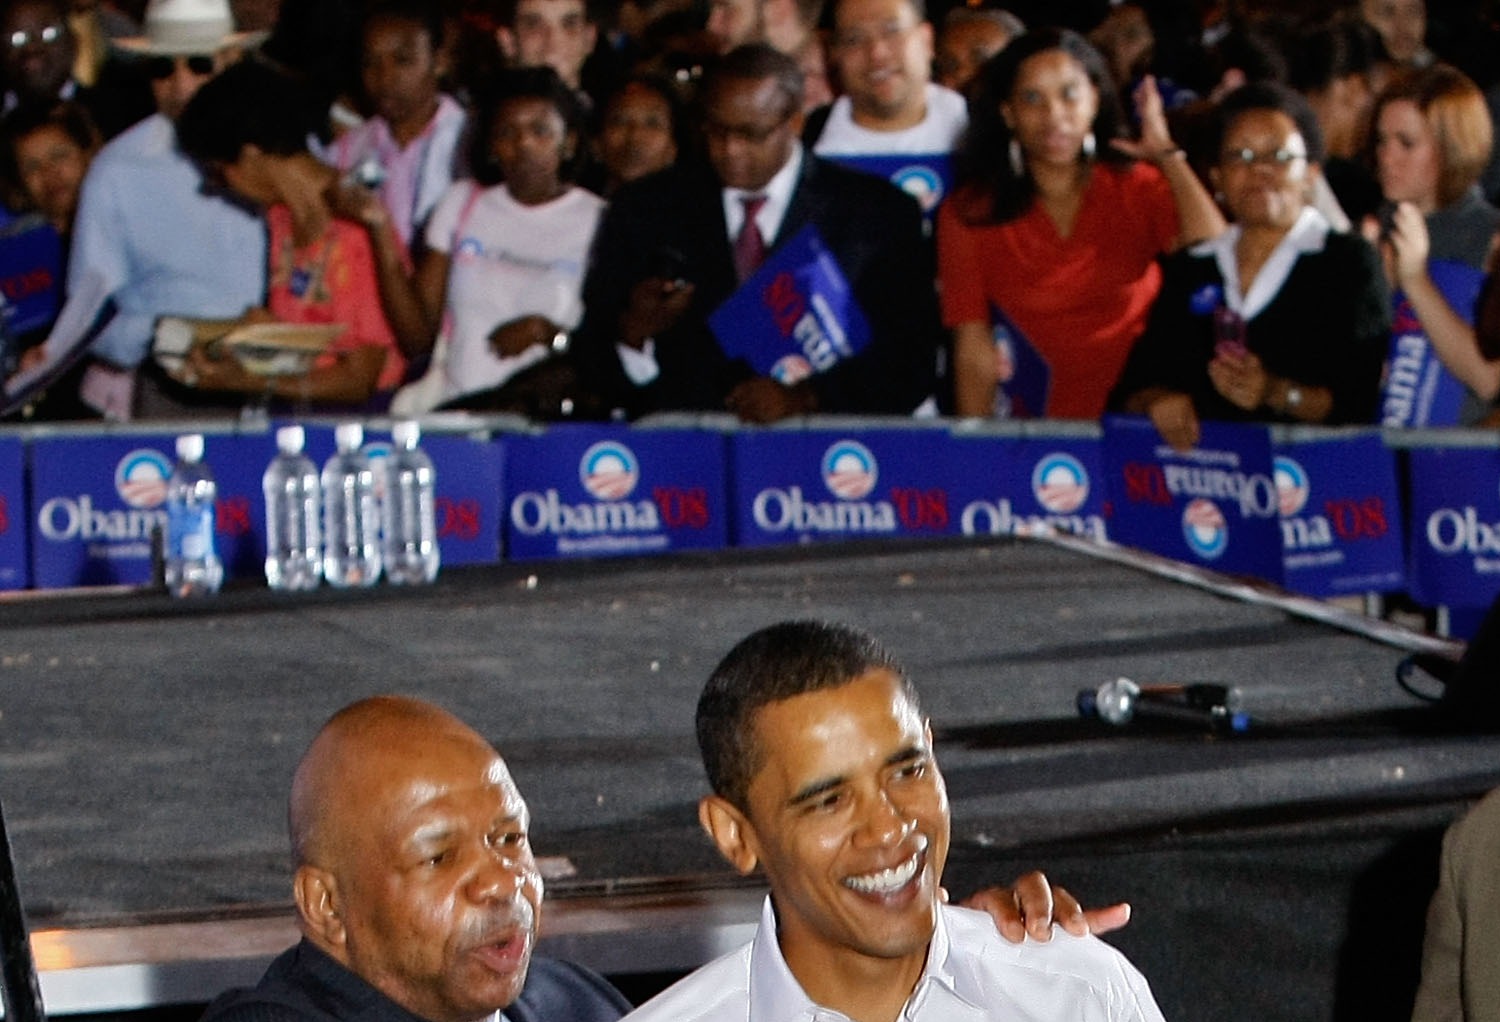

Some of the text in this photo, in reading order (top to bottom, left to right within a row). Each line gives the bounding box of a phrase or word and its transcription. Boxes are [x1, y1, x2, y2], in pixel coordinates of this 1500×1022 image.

[511, 489, 658, 535] Obama
[753, 486, 896, 532] Obama
[1163, 464, 1277, 518] Obama
[38, 494, 168, 542] Obam
